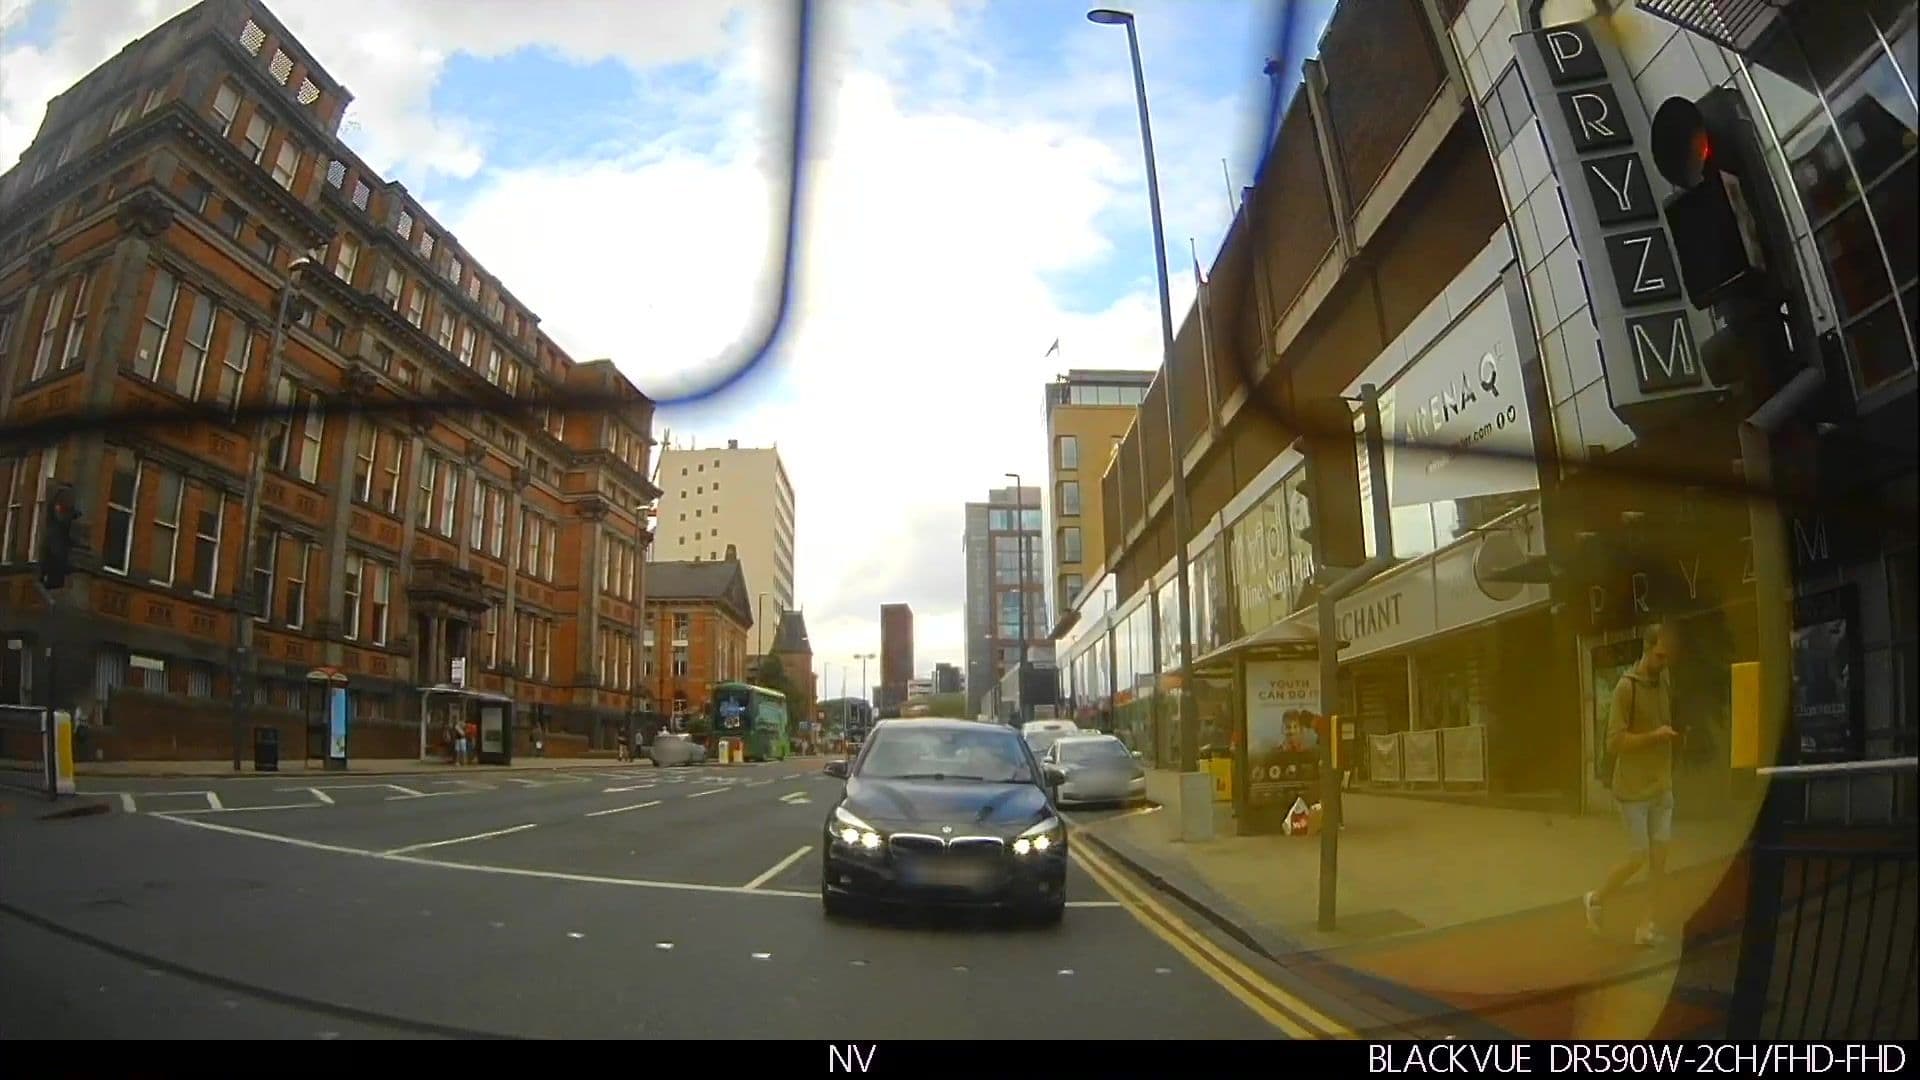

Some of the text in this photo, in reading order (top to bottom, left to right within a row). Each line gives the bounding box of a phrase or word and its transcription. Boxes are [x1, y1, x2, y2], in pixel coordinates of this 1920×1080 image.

[1546, 31, 1696, 382] PRYZM
[1335, 591, 1403, 642] CHANT
[1258, 690, 1285, 701] CAN
[1287, 690, 1306, 700] DO
[1269, 679, 1310, 689] YOUTH
